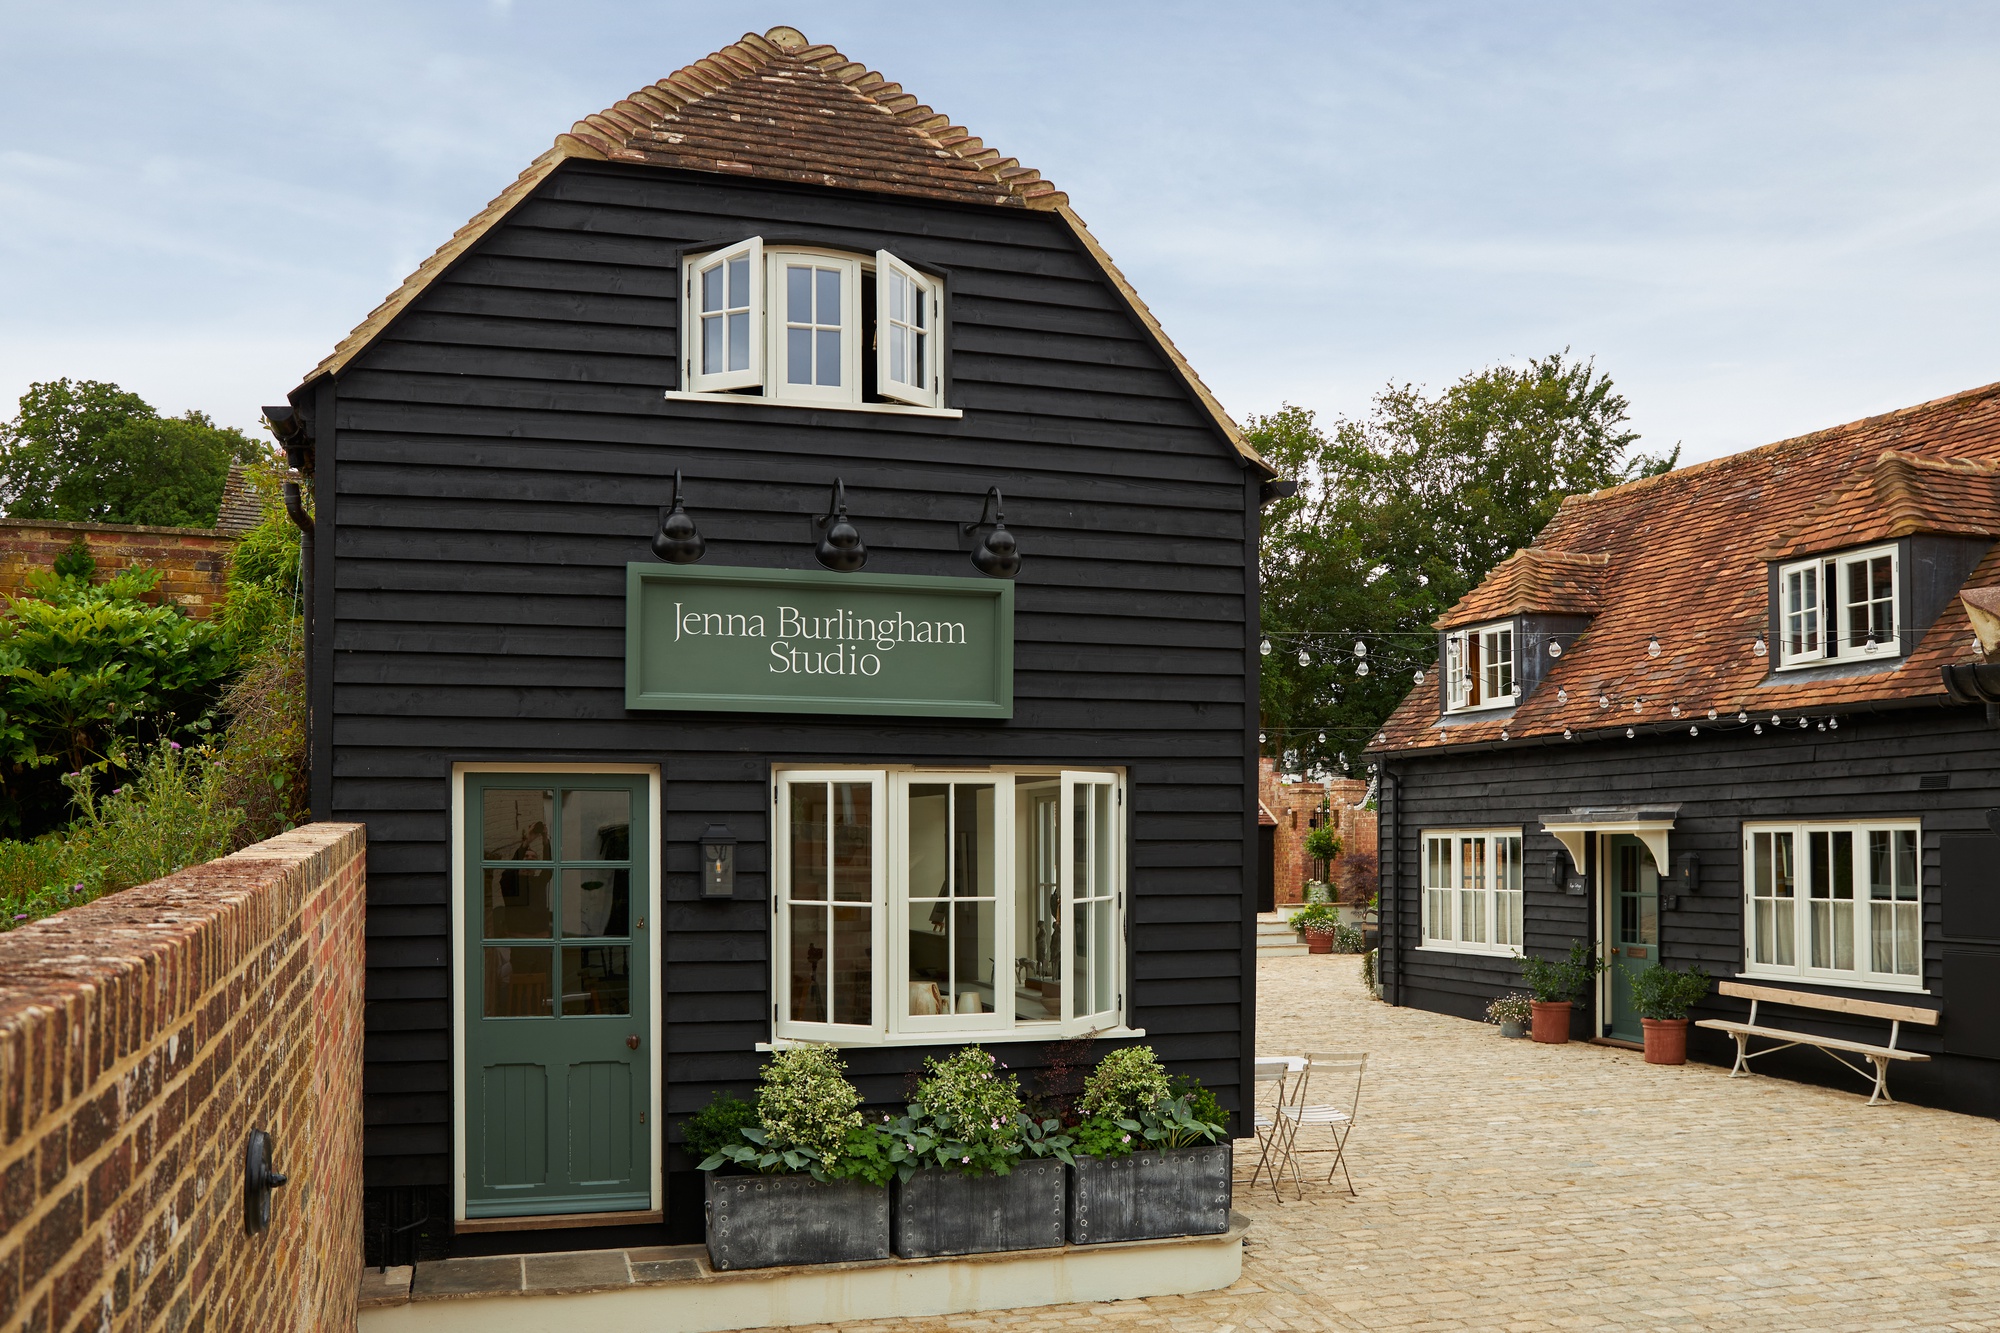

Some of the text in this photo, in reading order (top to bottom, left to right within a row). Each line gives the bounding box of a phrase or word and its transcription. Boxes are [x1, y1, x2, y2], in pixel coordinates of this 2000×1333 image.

[673, 602, 967, 651] Jenna Burlingham
[768, 641, 881, 676] Studio
